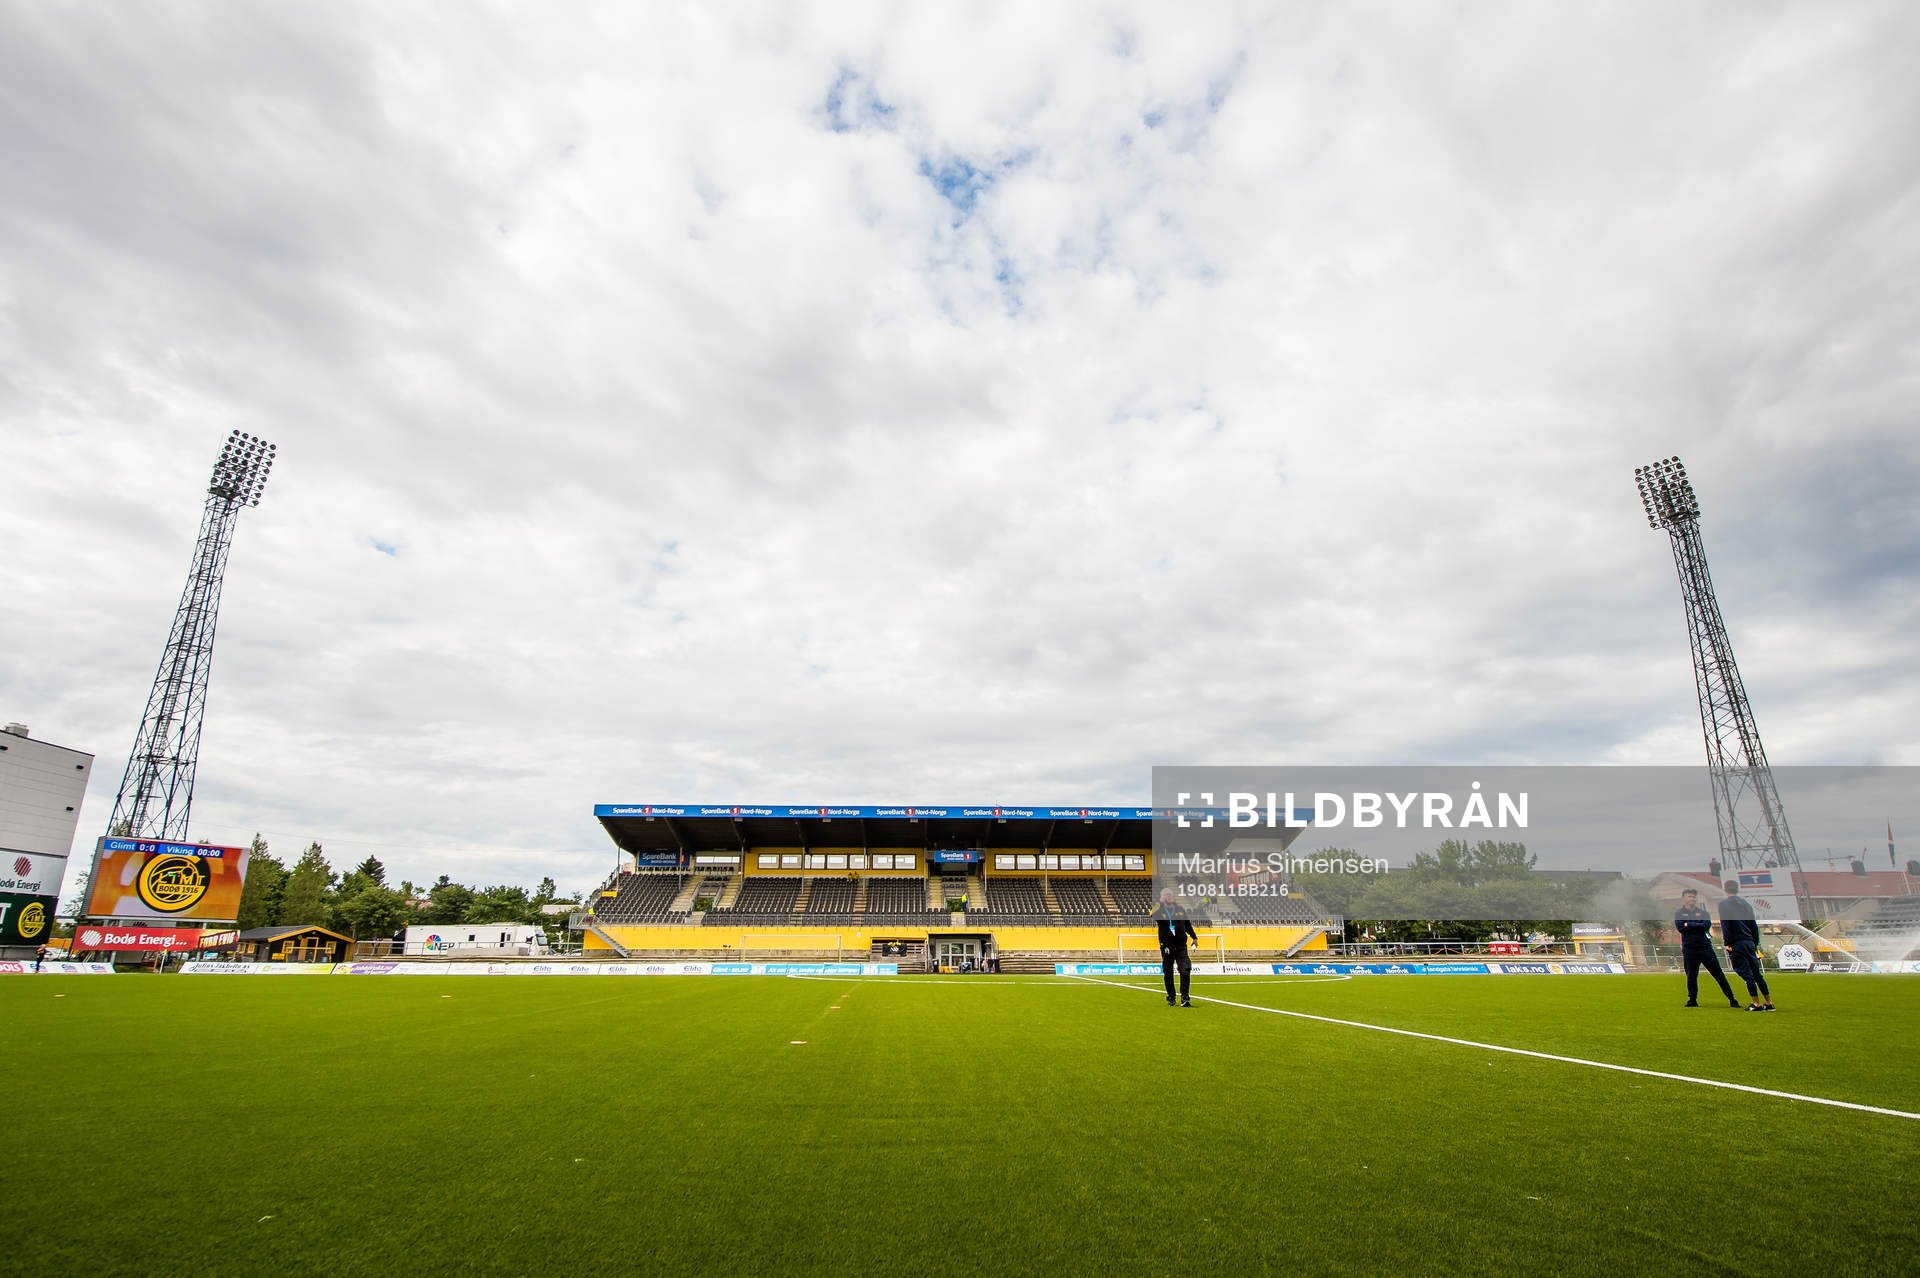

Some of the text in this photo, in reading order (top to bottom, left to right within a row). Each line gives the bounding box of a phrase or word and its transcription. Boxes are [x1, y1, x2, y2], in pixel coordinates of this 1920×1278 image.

[612, 807, 643, 815] SpareBank
[701, 807, 730, 816] SpareBank
[740, 808, 772, 816] Nord-Norge
[789, 808, 818, 817] SpareBank
[828, 809, 860, 817] Nord-Norge
[876, 809, 905, 817] SpareBank
[963, 809, 993, 817] SpareBank
[1050, 810, 1079, 818] SpareBank
[110, 841, 220, 857] Glimt 0:0 Viking 00:00
[642, 852, 676, 860] SpareBank
[0, 879, 41, 892] odø Energi
[181, 886, 198, 894] 1916
[104, 933, 136, 945] Bodø
[1131, 965, 1162, 975] an.no
[1505, 965, 1545, 973] laks.no
[1568, 965, 1606, 973] laks.no
